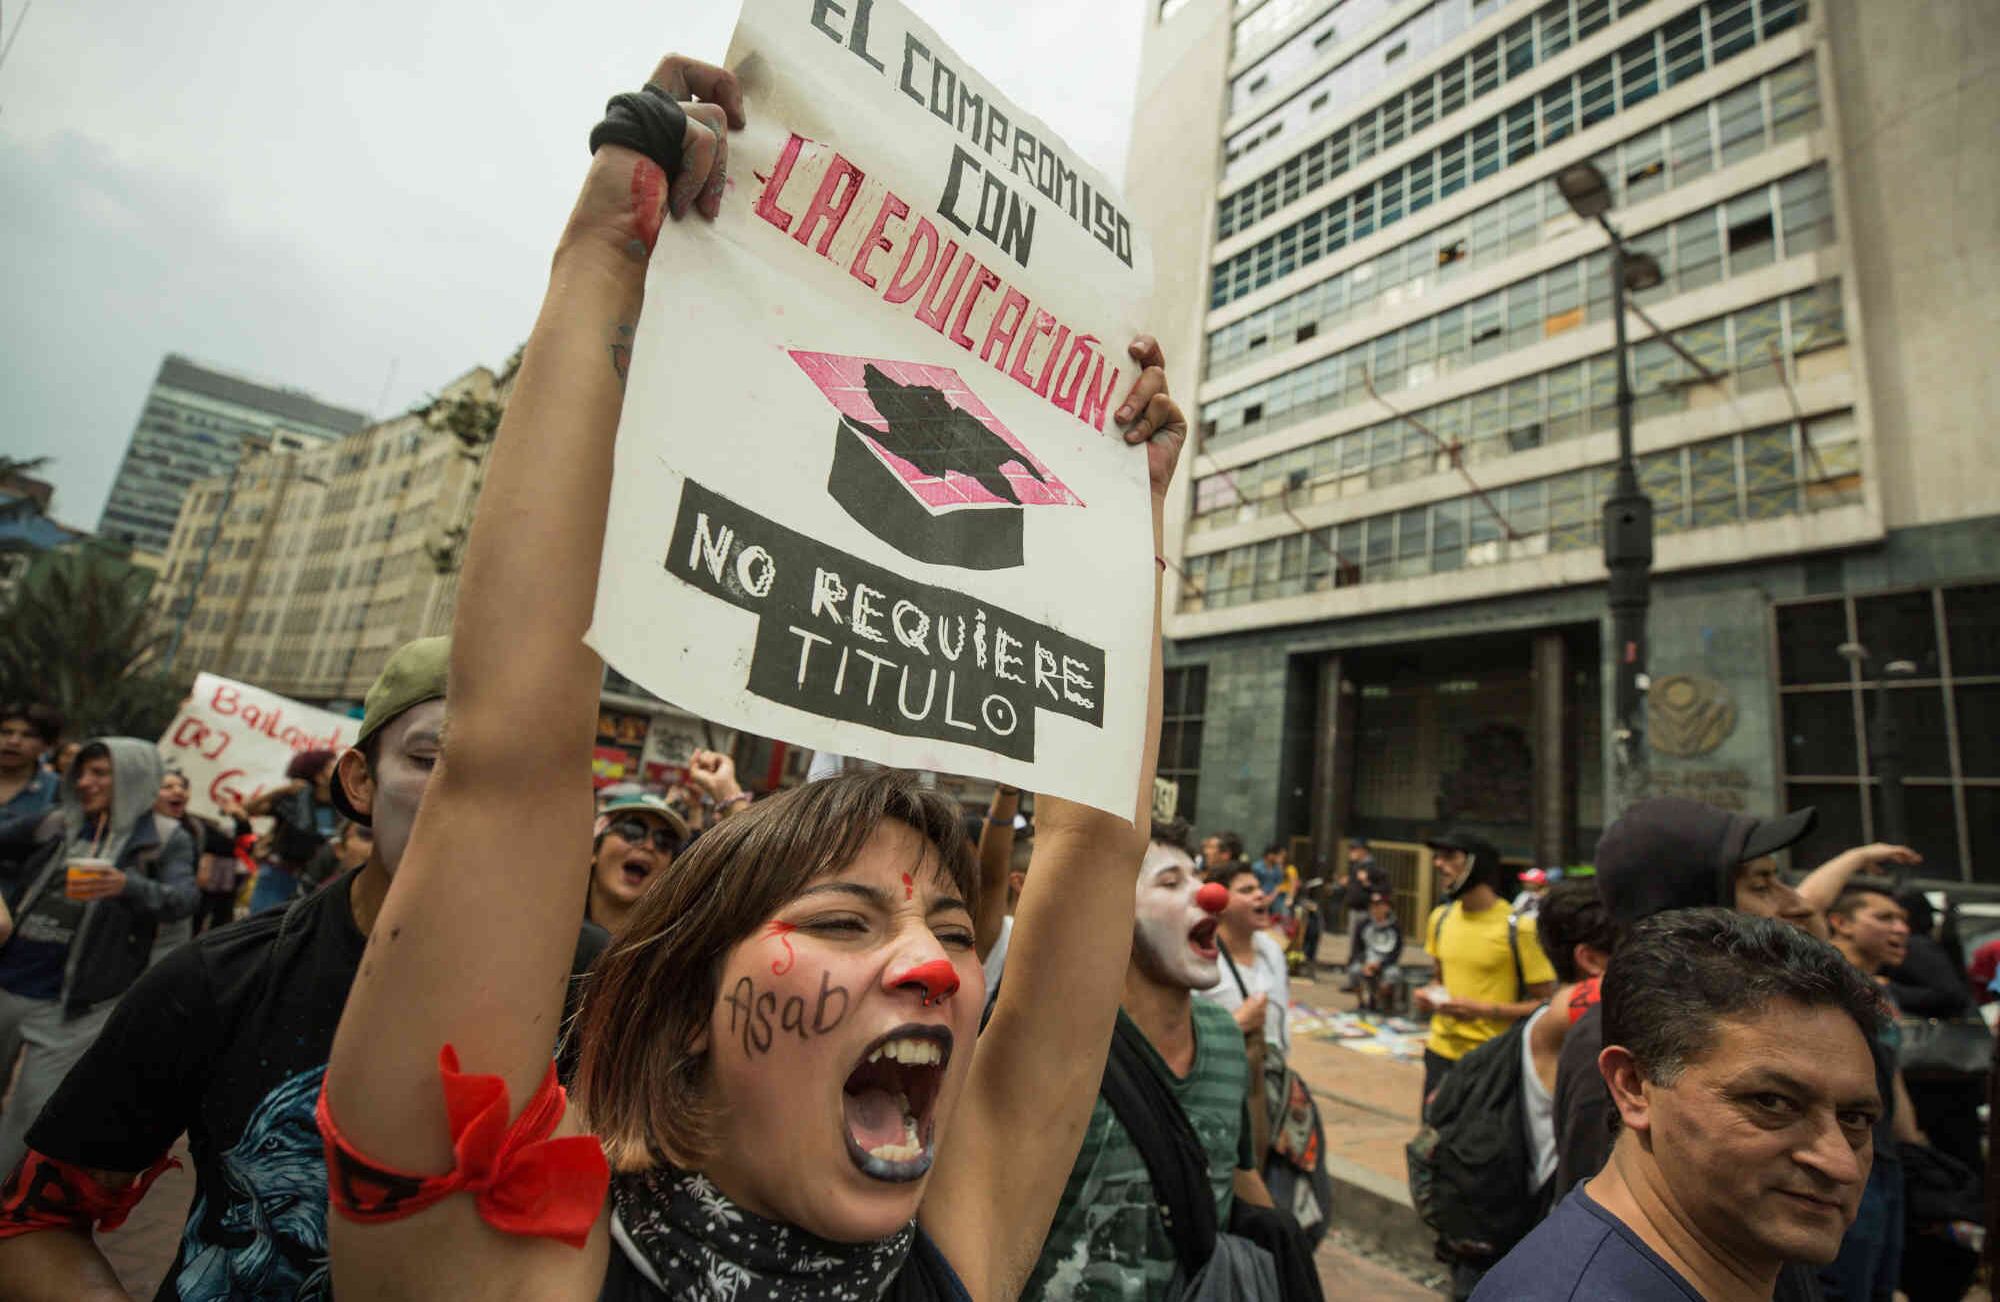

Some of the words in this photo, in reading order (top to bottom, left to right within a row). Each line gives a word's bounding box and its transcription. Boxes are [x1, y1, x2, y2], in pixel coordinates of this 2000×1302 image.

[811, 0, 885, 74] EL
[900, 31, 1133, 268] COMPROMISO
[752, 133, 865, 262] LA
[937, 144, 1036, 268] CON
[689, 513, 777, 598] NO
[789, 625, 1017, 736] TITULO
